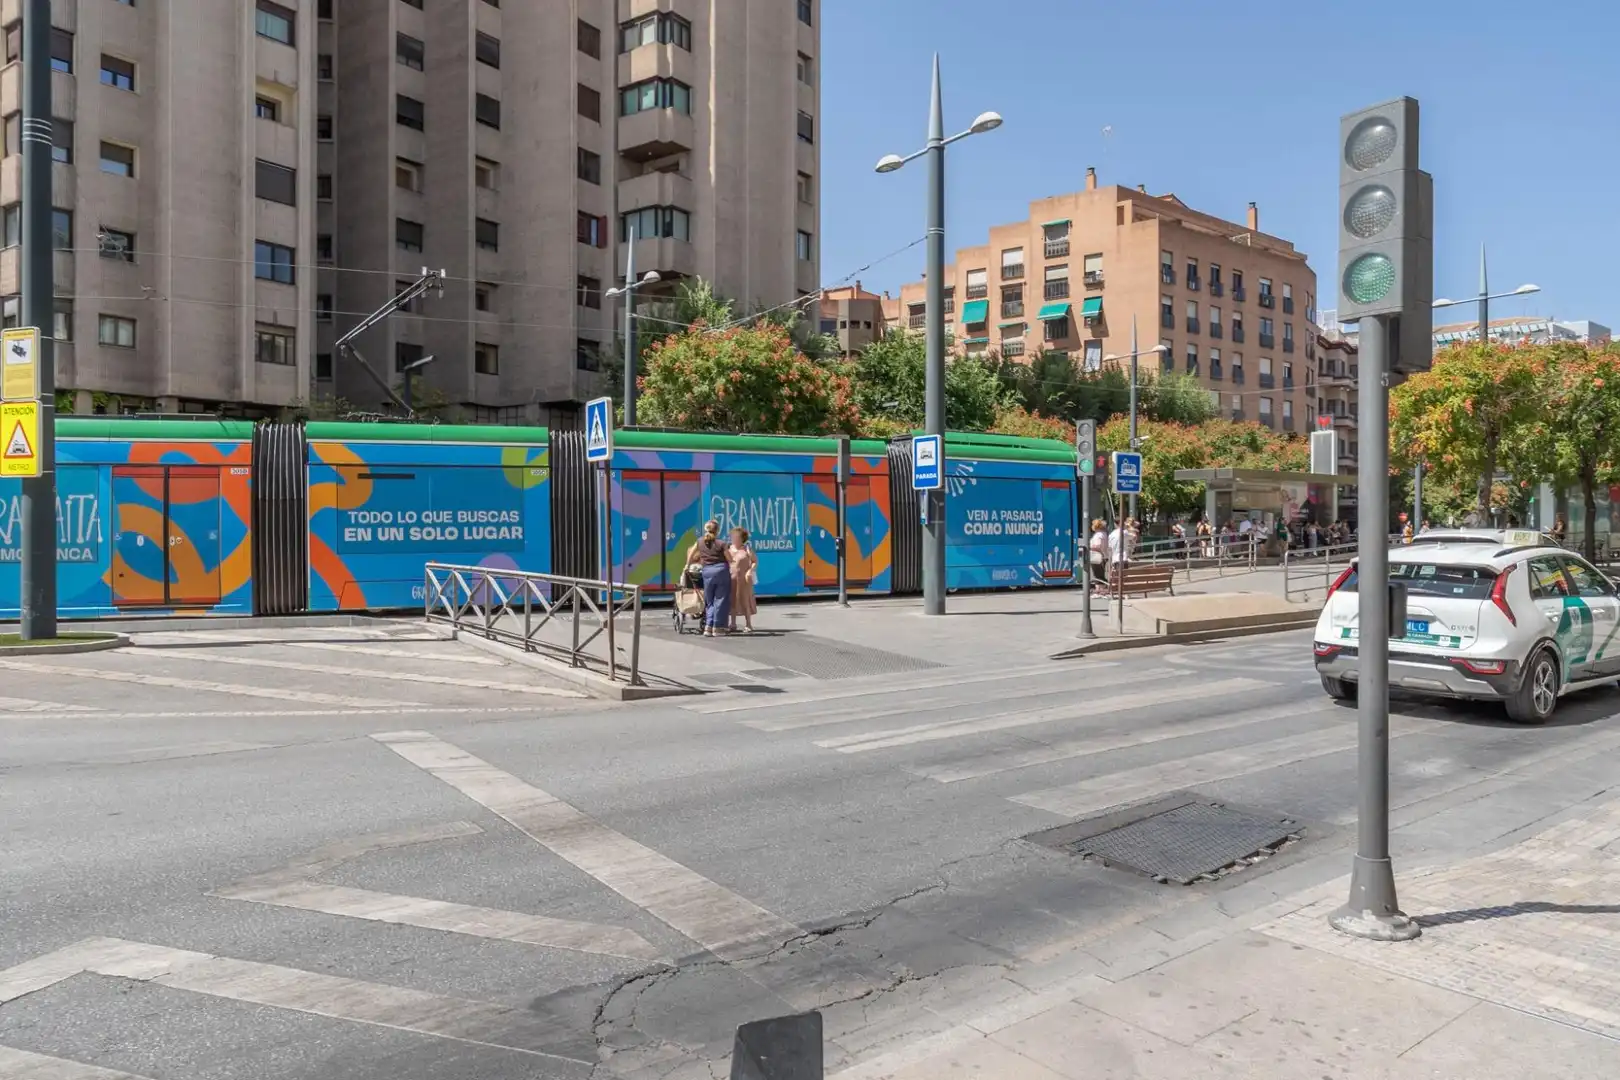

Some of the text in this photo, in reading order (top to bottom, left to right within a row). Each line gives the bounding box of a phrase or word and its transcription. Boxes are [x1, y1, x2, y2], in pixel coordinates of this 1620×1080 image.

[347, 510, 520, 524] TODO LO QUE BUSCAS
[966, 510, 1043, 521] VEN A PASARLO
[344, 526, 523, 542] EN UN SOLO LUGAR
[964, 523, 1043, 535] COMO NUNCA
[755, 540, 793, 550] NUNCA
[56, 548, 93, 560] NCA
